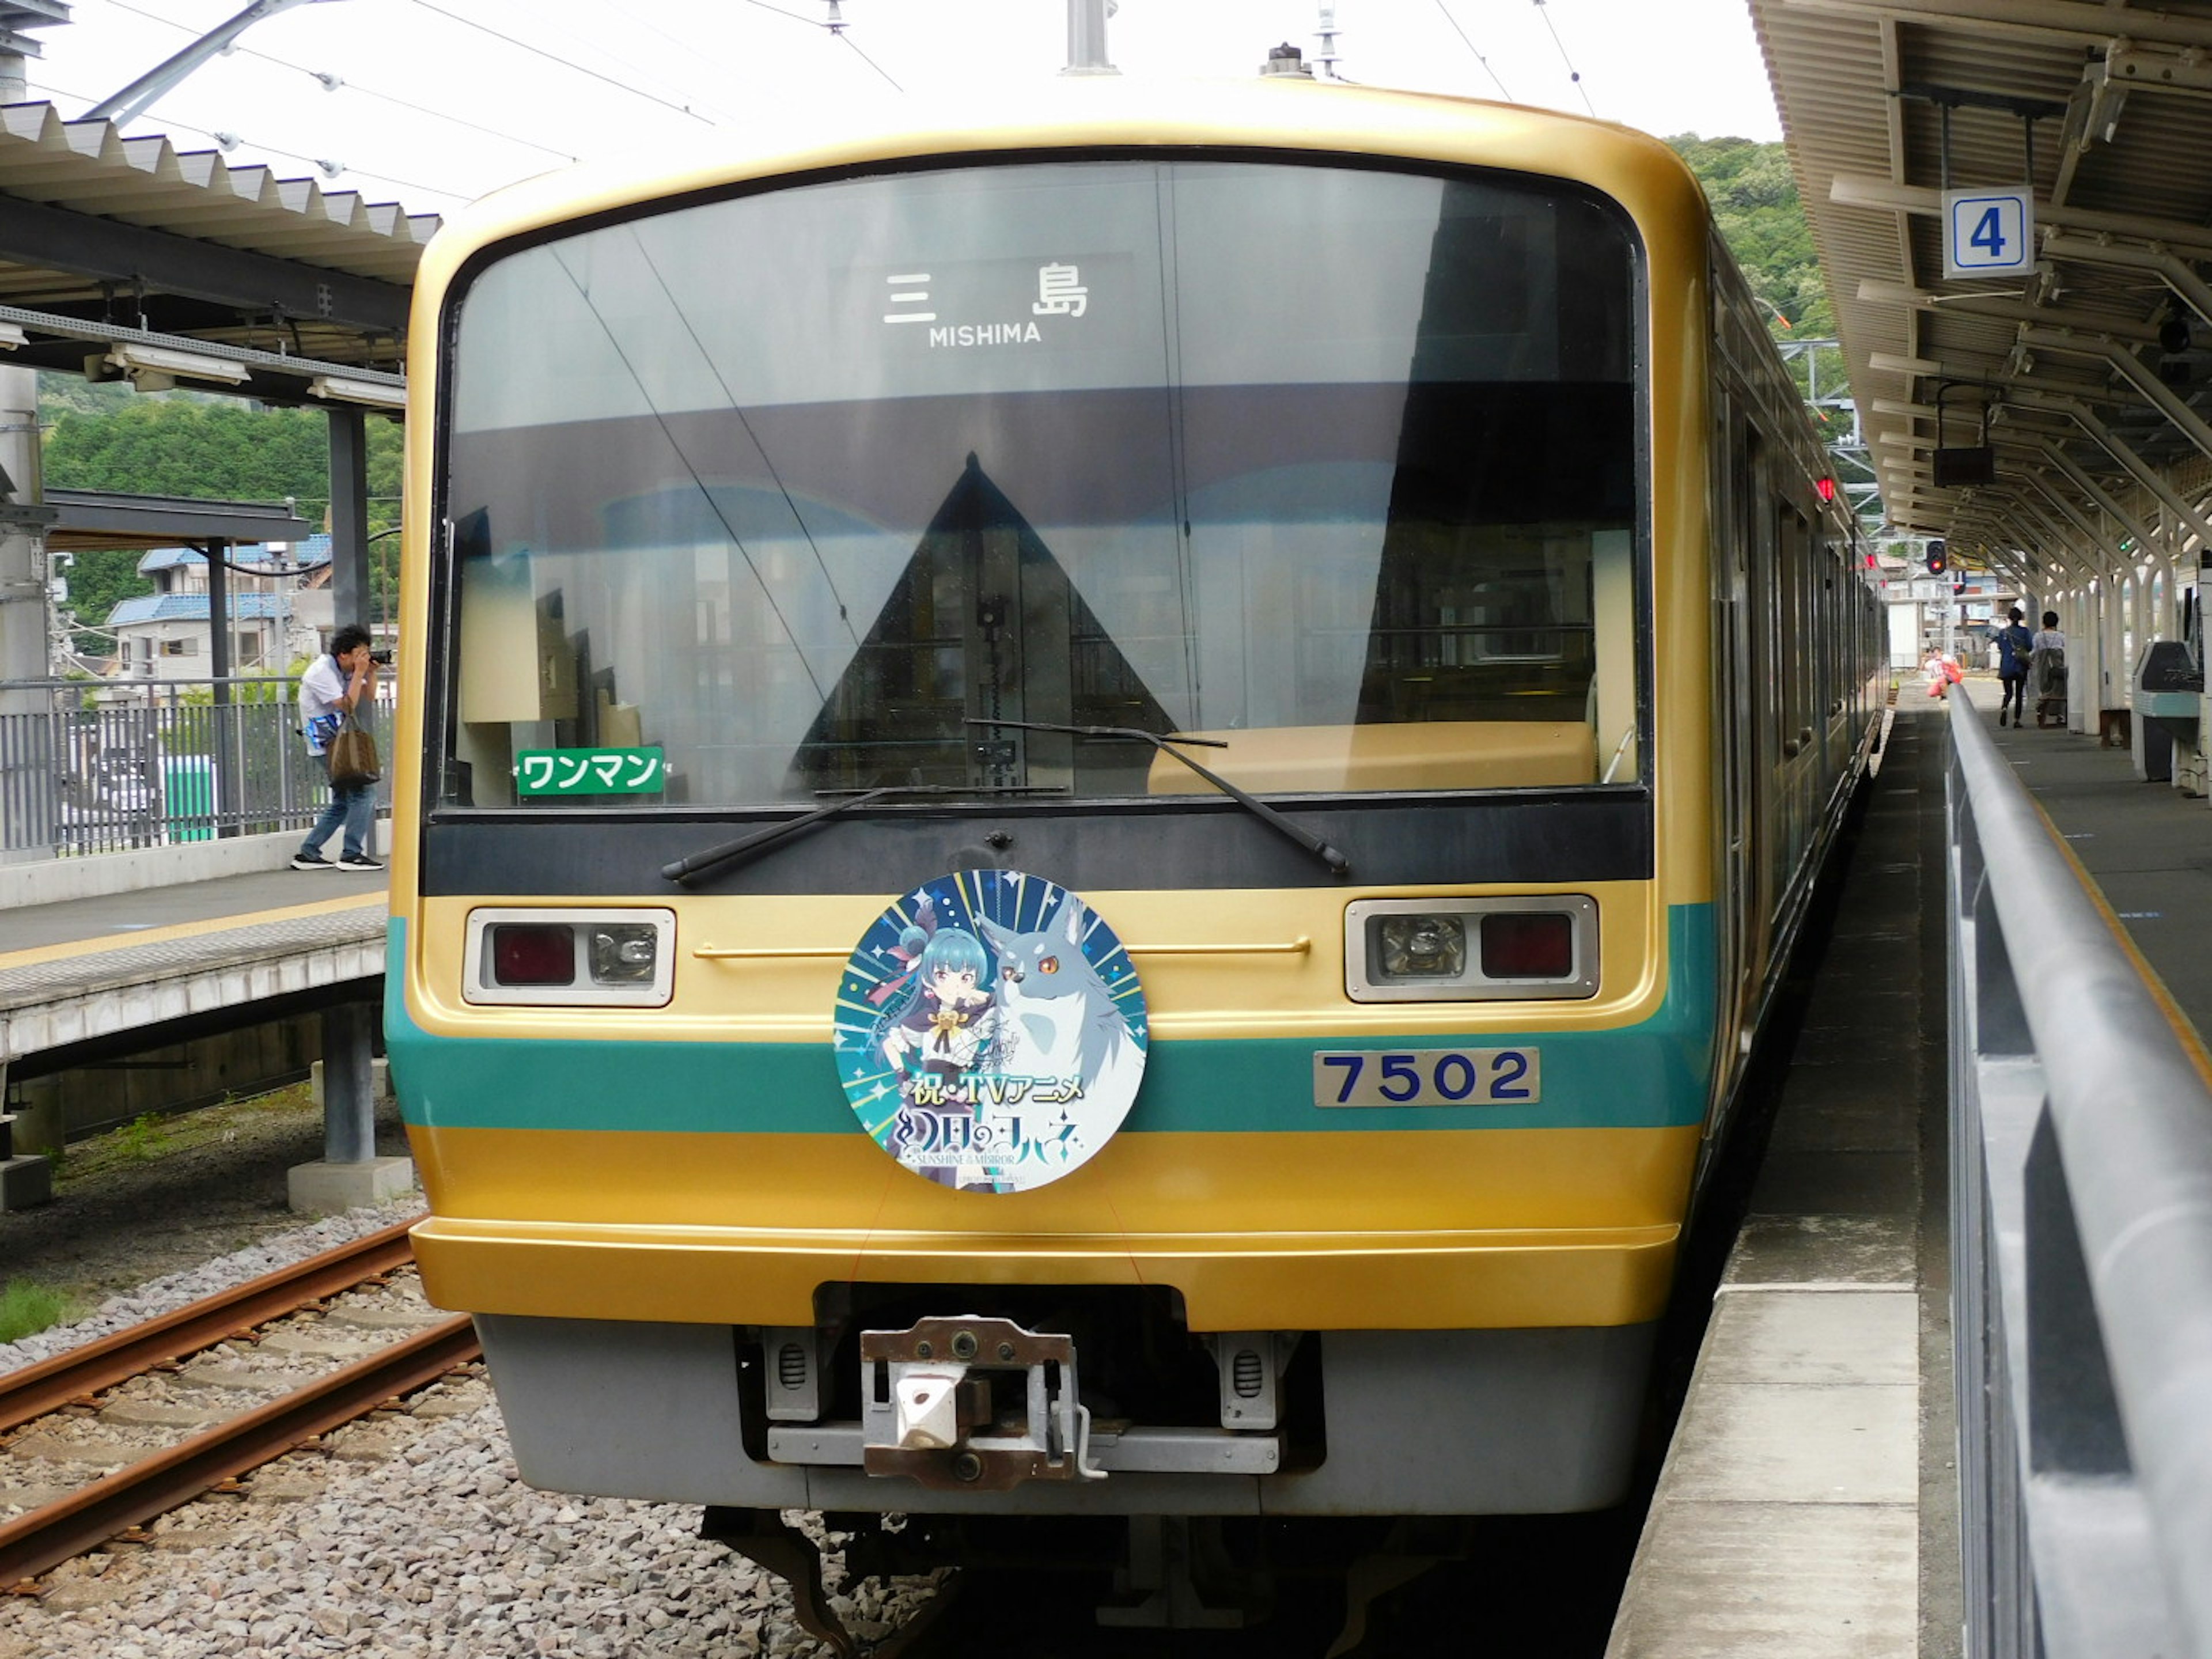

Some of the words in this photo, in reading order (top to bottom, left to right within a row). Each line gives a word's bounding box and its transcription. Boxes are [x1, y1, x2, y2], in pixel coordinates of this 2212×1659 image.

[1971, 207, 2006, 256] 4
[884, 262, 1088, 323] 三島
[930, 321, 1041, 347] MISHIMA
[524, 755, 657, 789] ワンマン
[910, 1071, 1084, 1106] 祝・TVアニメ
[1323, 1052, 1530, 1103] 7502
